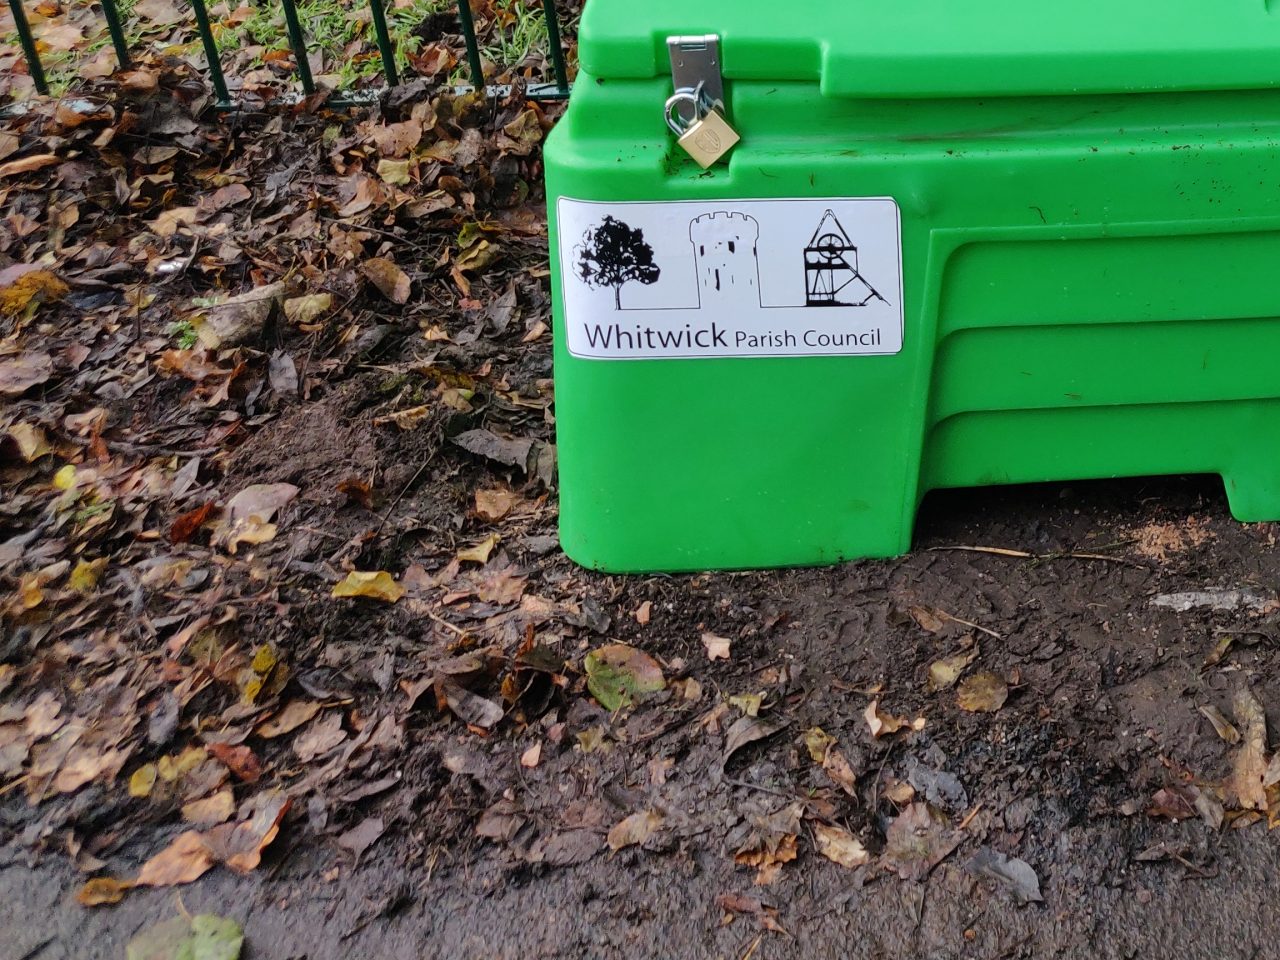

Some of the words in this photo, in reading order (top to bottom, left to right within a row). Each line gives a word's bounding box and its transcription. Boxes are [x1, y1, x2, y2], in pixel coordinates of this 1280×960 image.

[584, 322, 728, 349] Whitwick
[735, 329, 796, 348] Parish
[803, 328, 881, 347] Council
